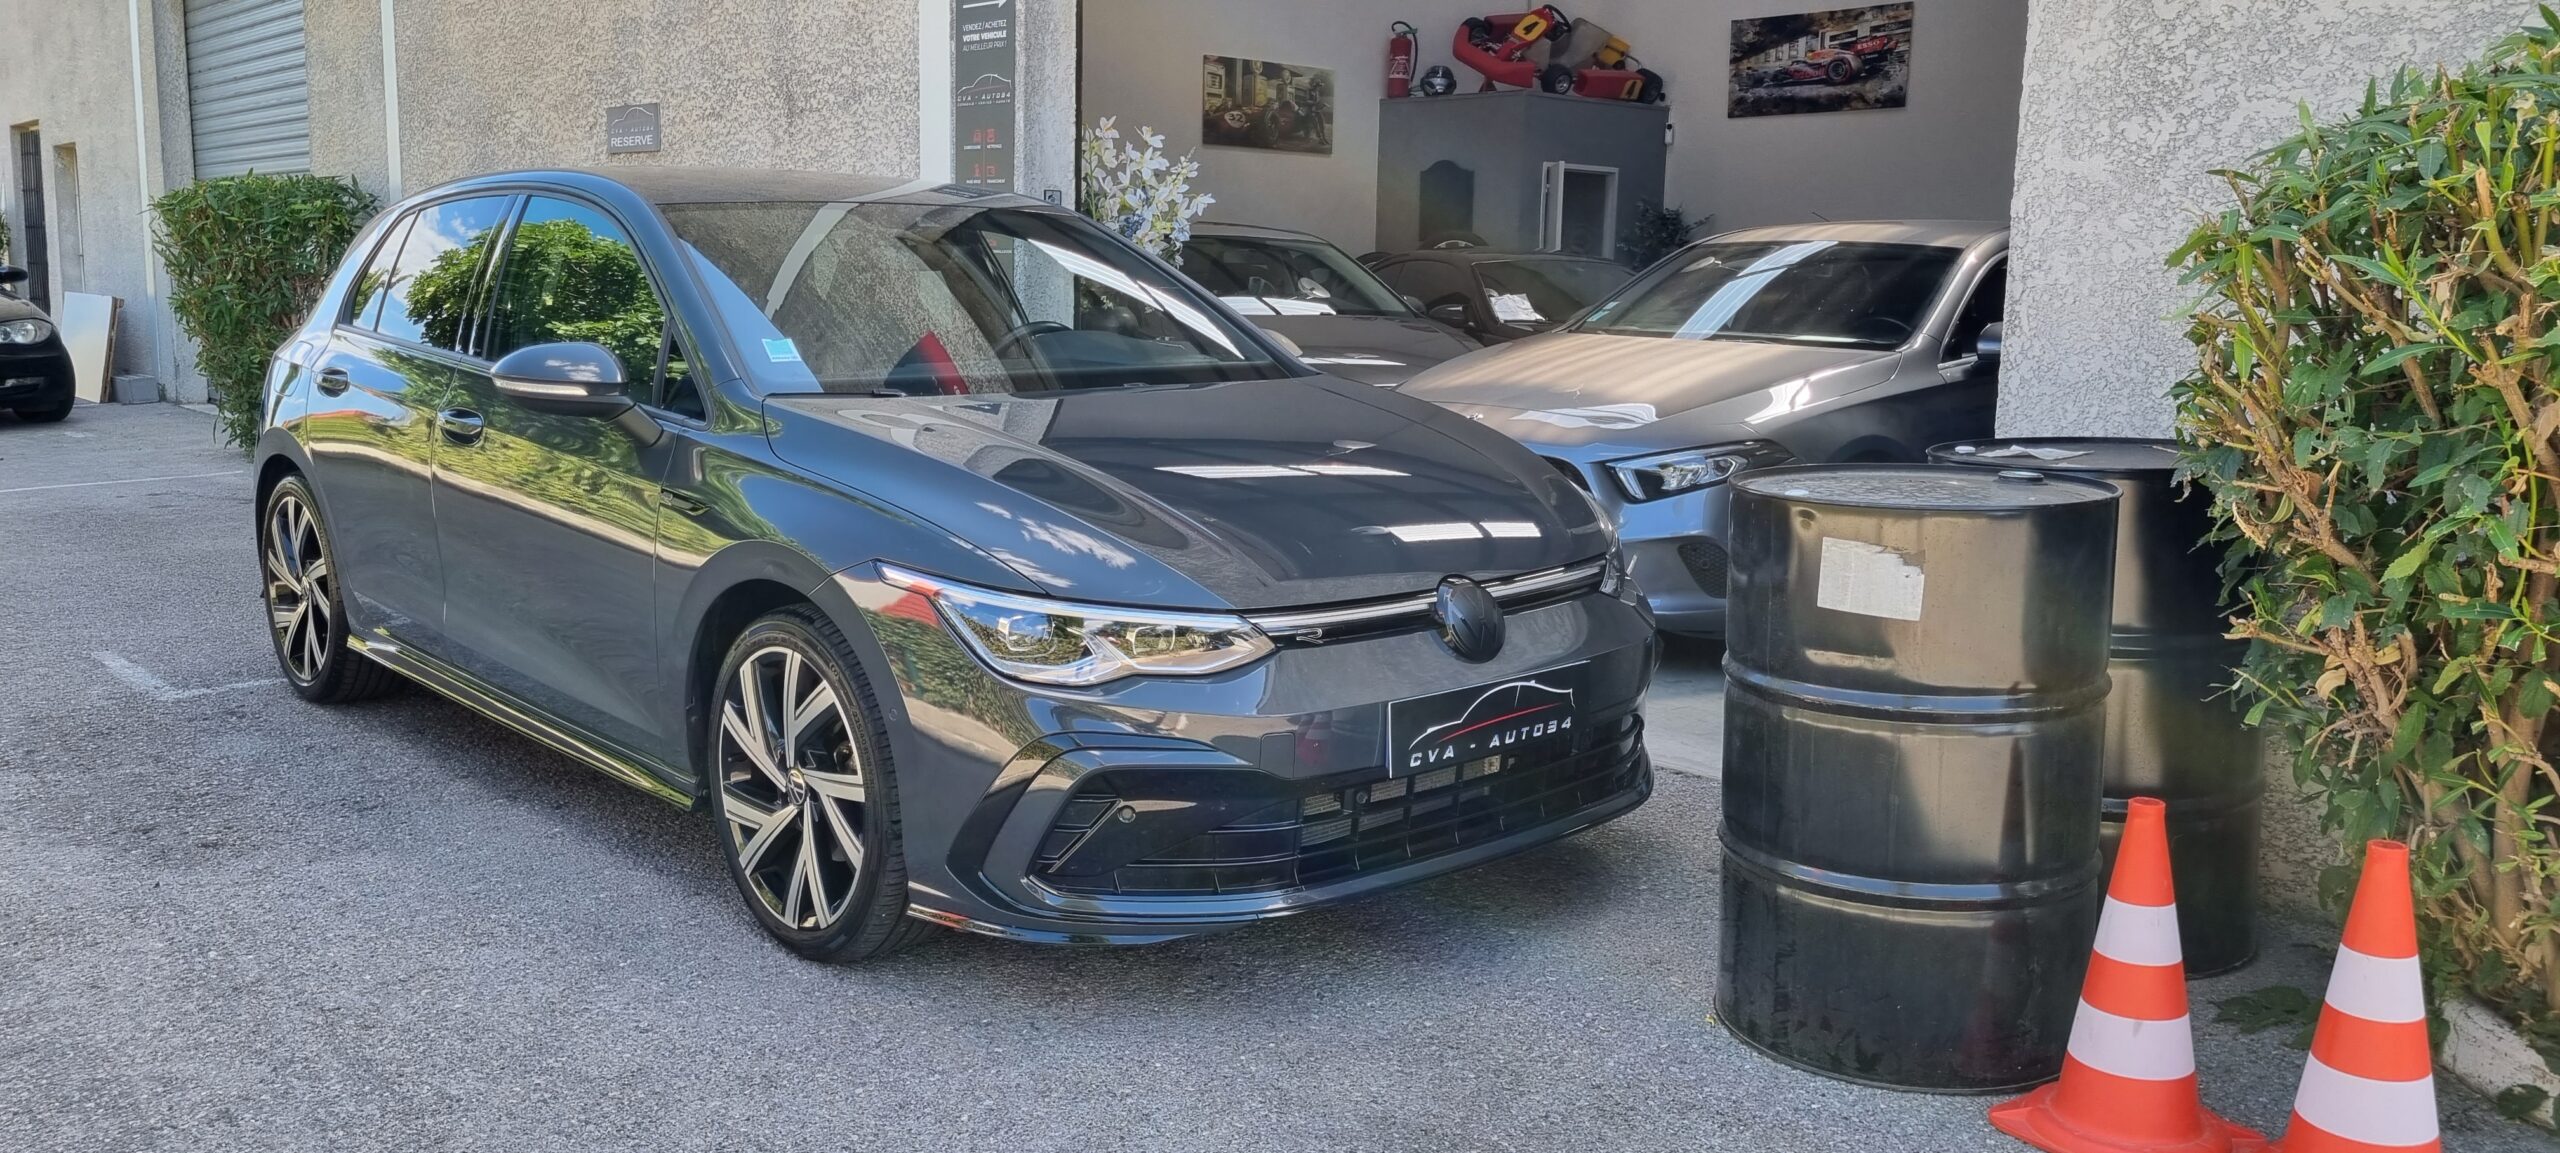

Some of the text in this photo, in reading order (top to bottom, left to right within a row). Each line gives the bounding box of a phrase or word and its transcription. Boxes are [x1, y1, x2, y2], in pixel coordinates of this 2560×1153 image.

[962, 33, 980, 42] VOTRE
[611, 135, 653, 147] RESERVE
[1409, 745, 1455, 768] CVA
[1489, 716, 1572, 749] AUTO34
